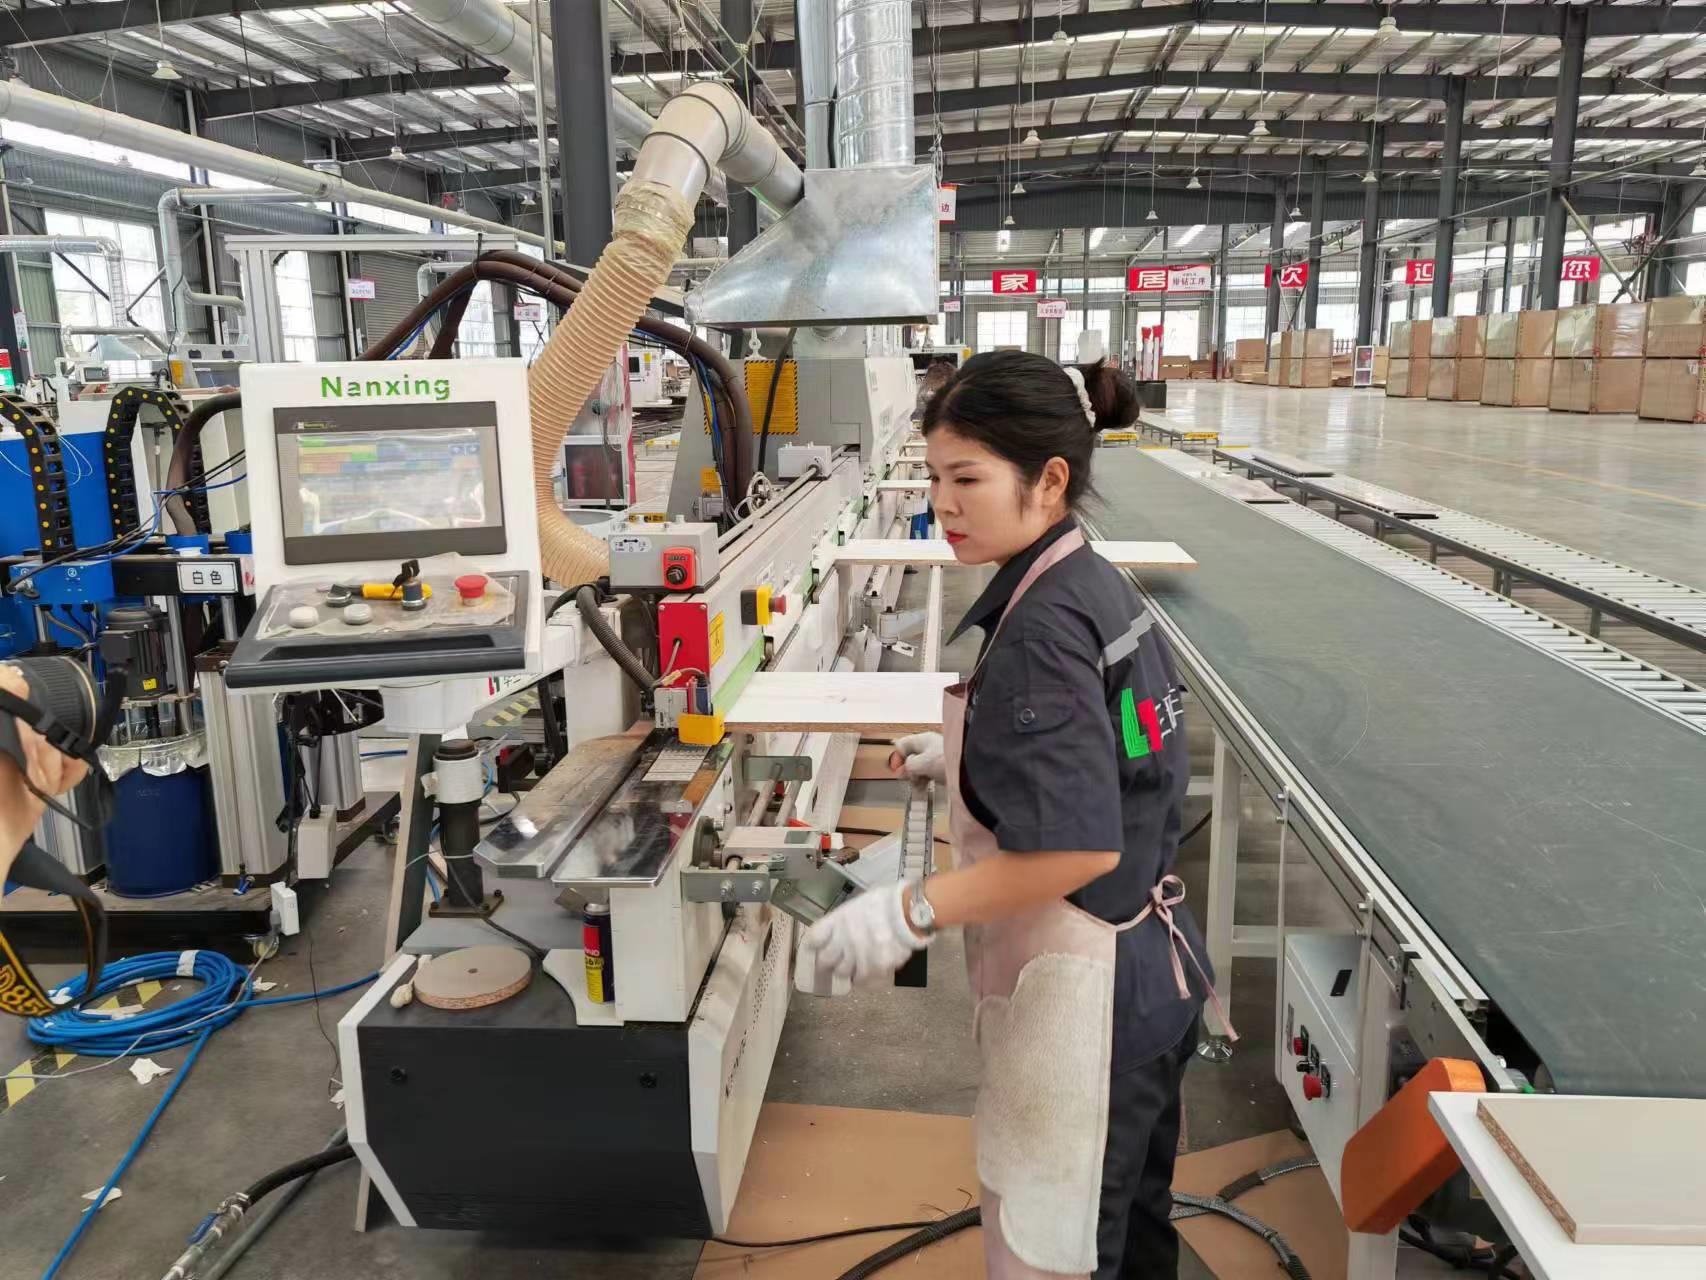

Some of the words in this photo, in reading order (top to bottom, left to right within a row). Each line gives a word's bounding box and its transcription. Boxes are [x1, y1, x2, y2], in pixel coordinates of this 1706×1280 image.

[1000, 273, 1028, 291] 家
[1138, 270, 1166, 288] 居
[321, 374, 450, 400] Nanxing
[192, 570, 222, 584] 白色
